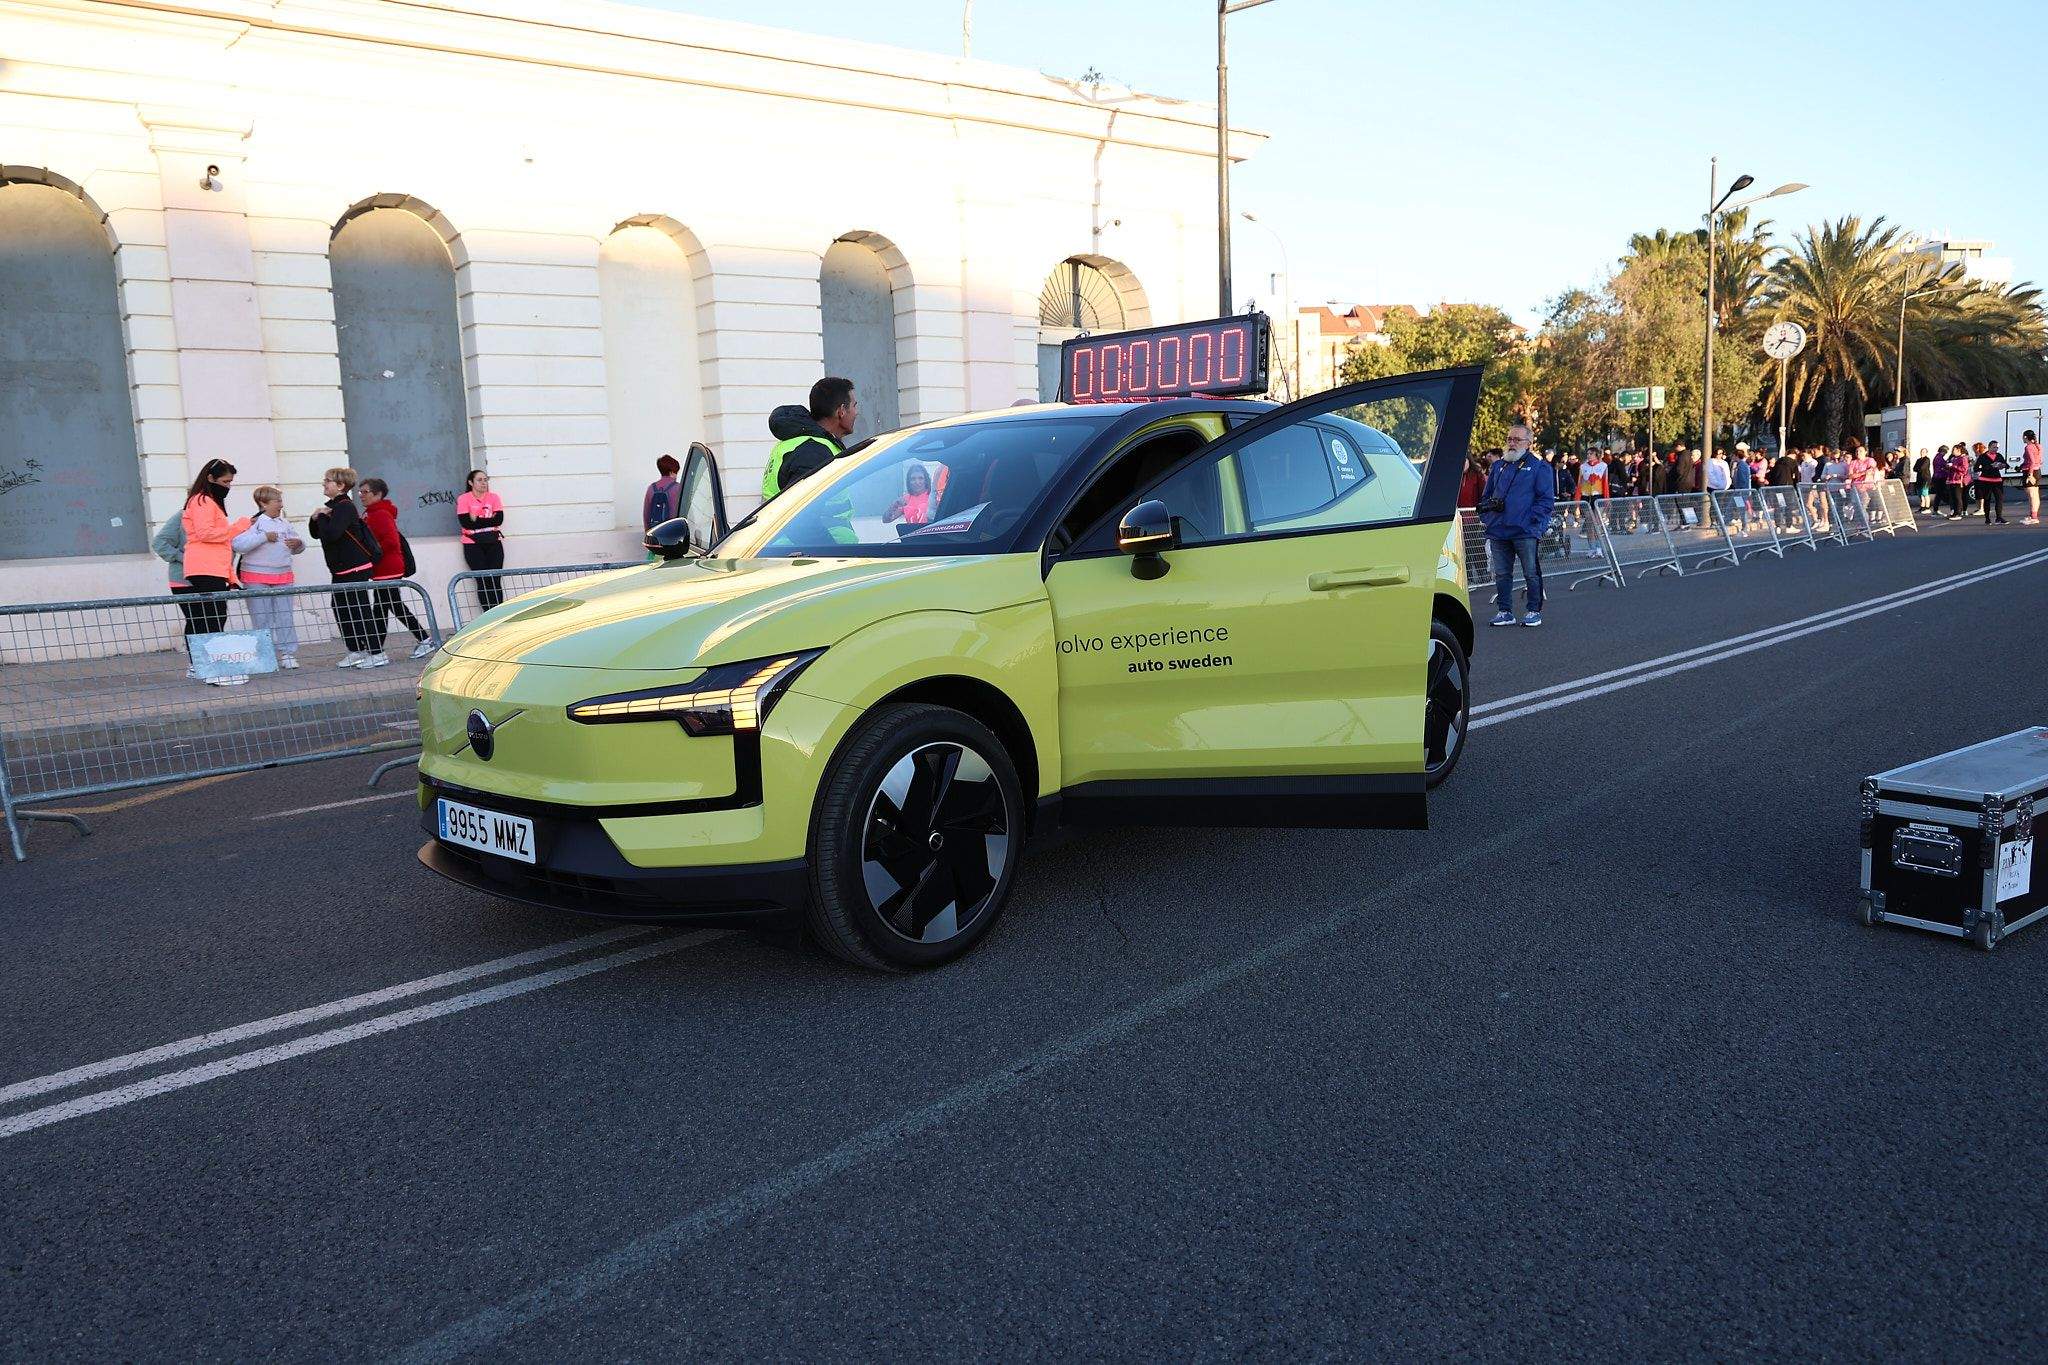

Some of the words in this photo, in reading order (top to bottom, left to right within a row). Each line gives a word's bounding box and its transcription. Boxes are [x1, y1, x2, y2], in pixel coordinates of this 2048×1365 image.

[1111, 626, 1229, 652] experience
[1128, 658, 1164, 673] auto
[1168, 654, 1233, 670] sweden
[449, 807, 488, 845] 9955
[494, 818, 529, 856] MMZ
